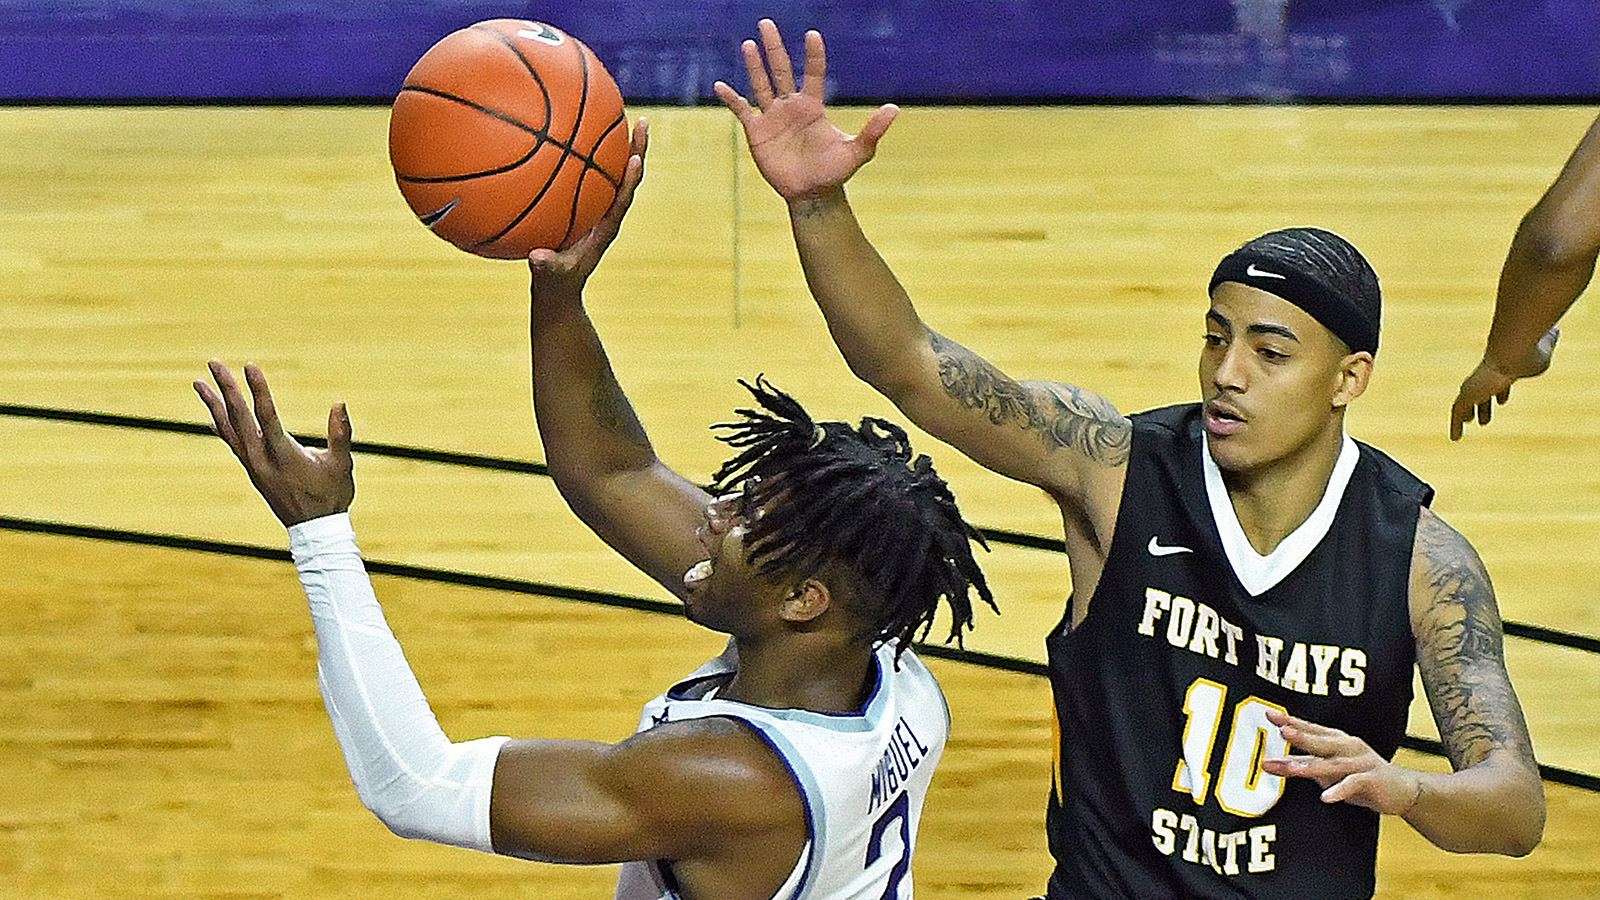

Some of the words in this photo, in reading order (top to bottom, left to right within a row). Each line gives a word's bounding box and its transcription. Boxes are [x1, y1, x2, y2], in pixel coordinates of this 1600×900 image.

[1138, 587, 1243, 665] FORT
[1256, 633, 1367, 697] HAYS
[867, 716, 929, 815] MIGUEL
[1172, 677, 1291, 818] 10
[864, 789, 911, 900] 2
[1152, 808, 1277, 876] STATE
